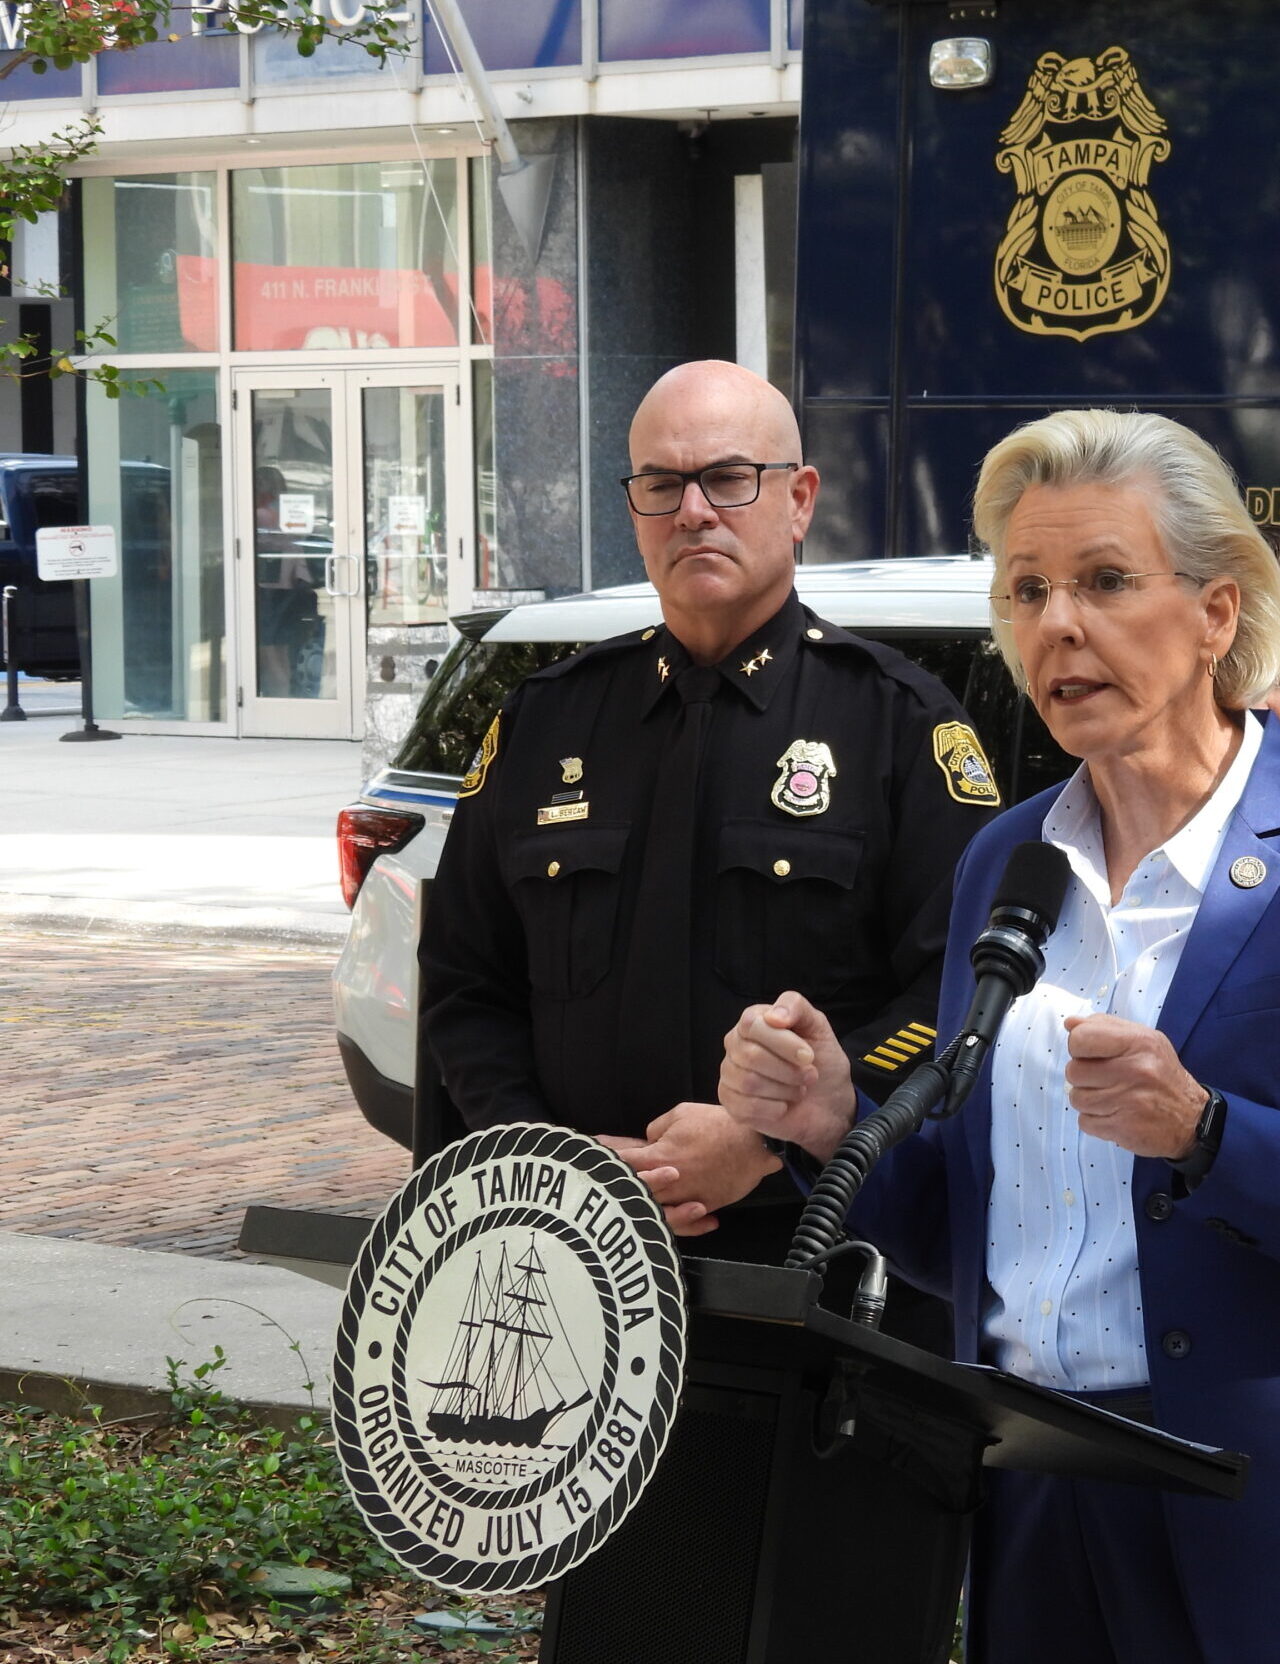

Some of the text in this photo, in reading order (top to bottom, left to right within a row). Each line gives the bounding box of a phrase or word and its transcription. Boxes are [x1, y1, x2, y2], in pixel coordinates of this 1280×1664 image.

[1042, 142, 1120, 174] TAMPA
[1056, 184, 1073, 204] CITY
[1075, 181, 1087, 190] OF
[1064, 256, 1101, 271] FLORIDA
[261, 281, 287, 300] 411
[1037, 279, 1125, 311] POLICE
[370, 1161, 655, 1333] CITY OF TAMPA FLORIDA
[358, 1383, 644, 1557] ORGANIZED JULY 15 1887
[454, 1458, 528, 1479] MASCOTTE
